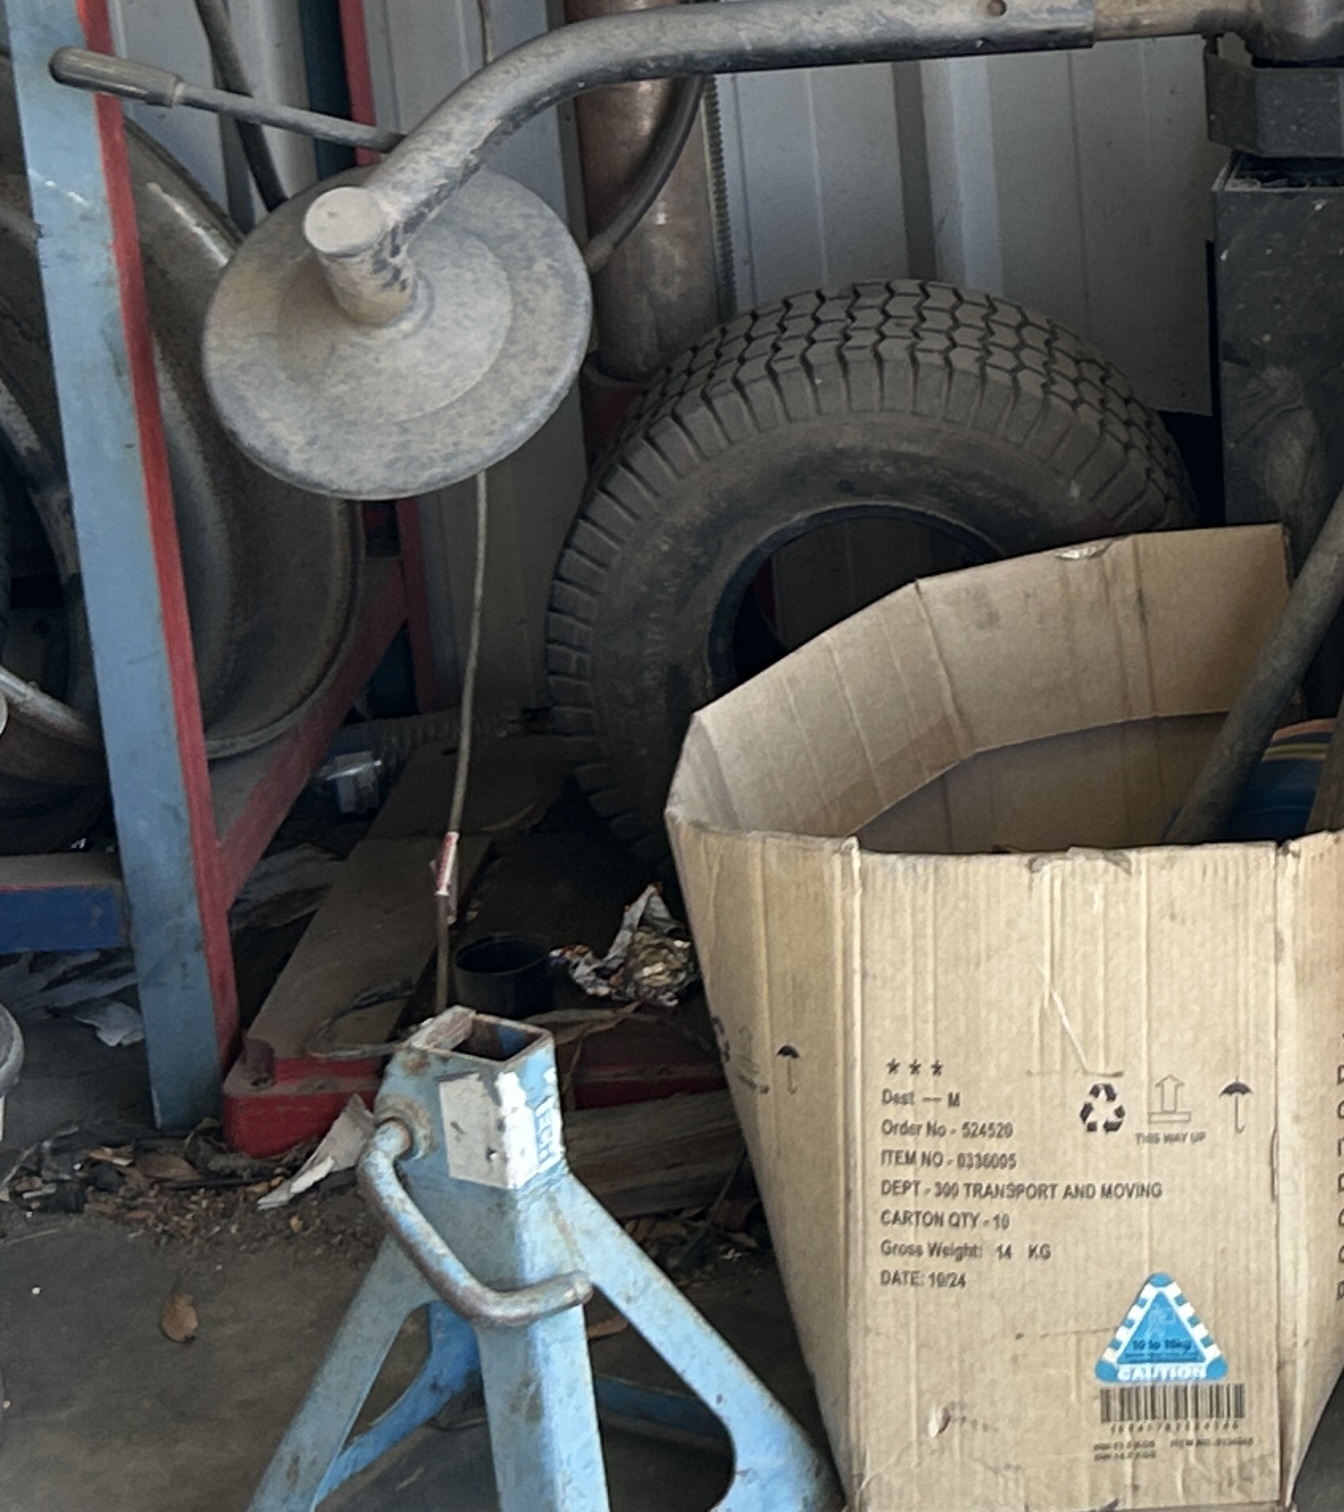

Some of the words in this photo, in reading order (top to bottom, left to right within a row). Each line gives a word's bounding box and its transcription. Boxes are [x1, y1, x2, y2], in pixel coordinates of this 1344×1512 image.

[881, 1088, 915, 1106] Dest
[947, 1092, 961, 1108] M
[881, 1119, 922, 1136] Order
[926, 1121, 947, 1138] No
[961, 1121, 1013, 1139] 524520
[881, 1149, 917, 1167] ITEM
[921, 1150, 944, 1168] NO
[881, 1179, 921, 1197] DEPT
[934, 1181, 959, 1199] 300
[963, 1182, 1058, 1200] TRANSPORT
[1062, 1183, 1097, 1200] AND
[1100, 1182, 1163, 1199] MOVING
[880, 1209, 944, 1228] CARTON
[949, 1212, 981, 1230] QTY
[992, 1213, 1010, 1230] 10
[880, 1239, 923, 1257] Gross
[996, 1243, 1011, 1260] 14
[1028, 1243, 1051, 1260] KG
[880, 1270, 925, 1288] DATE:
[1118, 1366, 1206, 1382] CAUTION
